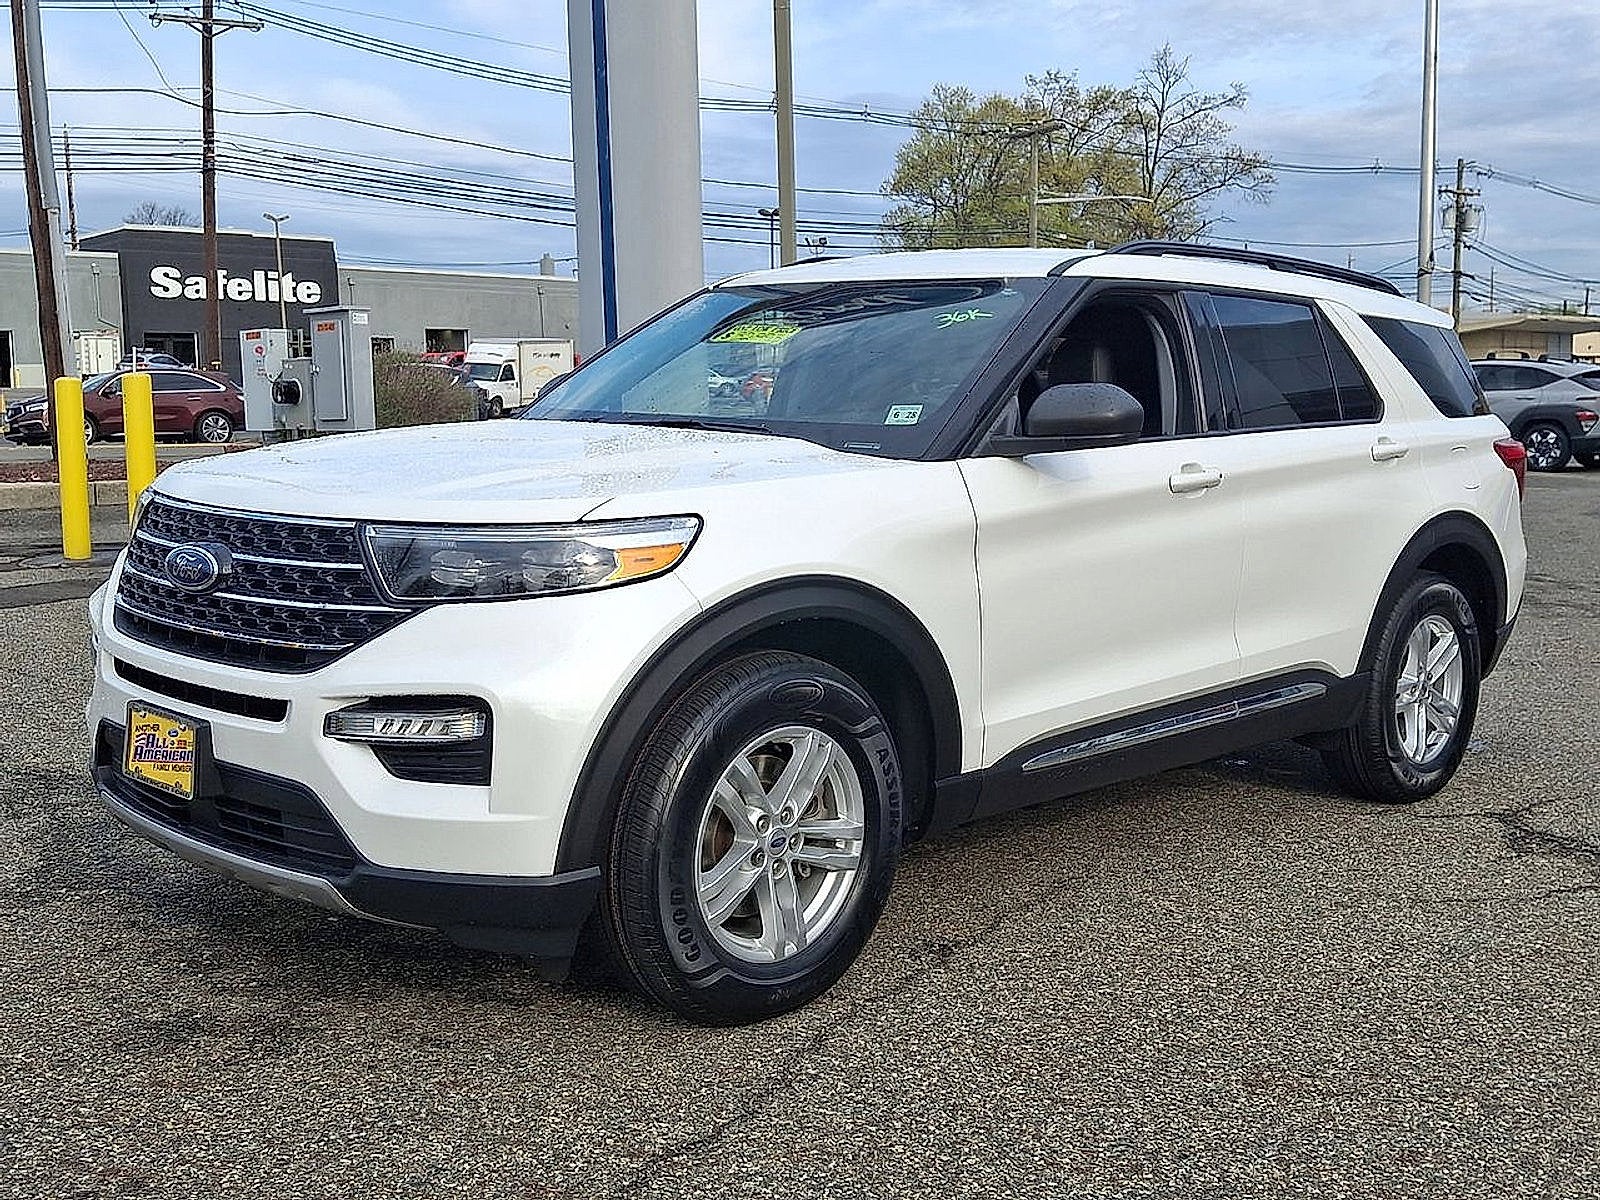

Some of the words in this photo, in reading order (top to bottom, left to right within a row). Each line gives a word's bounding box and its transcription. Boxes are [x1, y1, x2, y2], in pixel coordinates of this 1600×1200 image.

[150, 265, 322, 304] Safelite
[934, 308, 993, 329] 36K
[172, 553, 203, 580] Ford
[145, 733, 169, 749] ALL
[133, 746, 194, 761] AMERICAN
